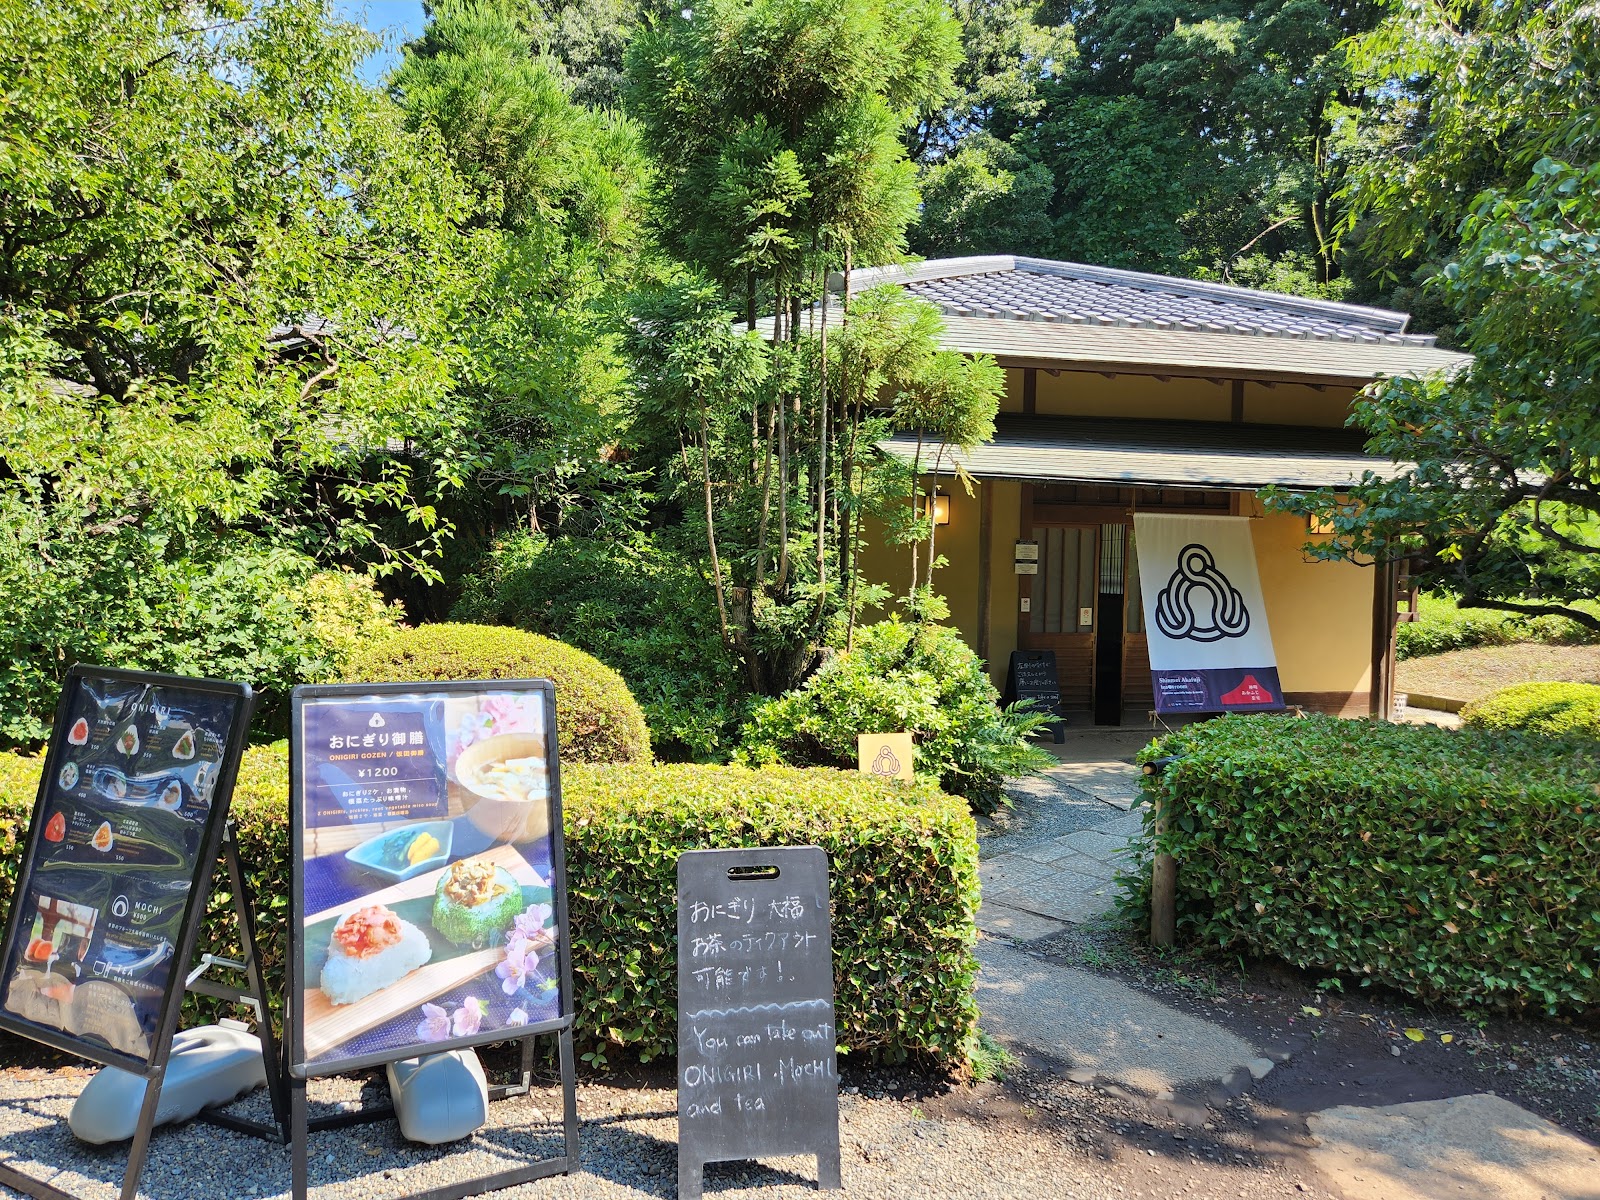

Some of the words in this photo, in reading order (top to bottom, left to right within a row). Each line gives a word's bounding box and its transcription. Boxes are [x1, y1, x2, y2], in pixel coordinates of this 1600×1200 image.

[131, 702, 171, 715] ONIGIRI
[329, 731, 424, 750] おにぎり御膳
[329, 753, 359, 761] ONIGIRI
[358, 766, 398, 778] ¥1200
[134, 901, 163, 915] MOCHI
[689, 896, 755, 924] おにぎり
[768, 895, 804, 920] 大福
[132, 911, 147, 921] ¥500
[117, 964, 134, 977] TEA
[693, 1025, 728, 1052] You
[736, 1033, 761, 1047] can
[764, 1019, 796, 1041] take
[801, 1022, 832, 1040] out
[684, 1062, 761, 1088] ONIGIRI
[686, 1096, 722, 1119] and
[735, 1092, 766, 1112] tea
